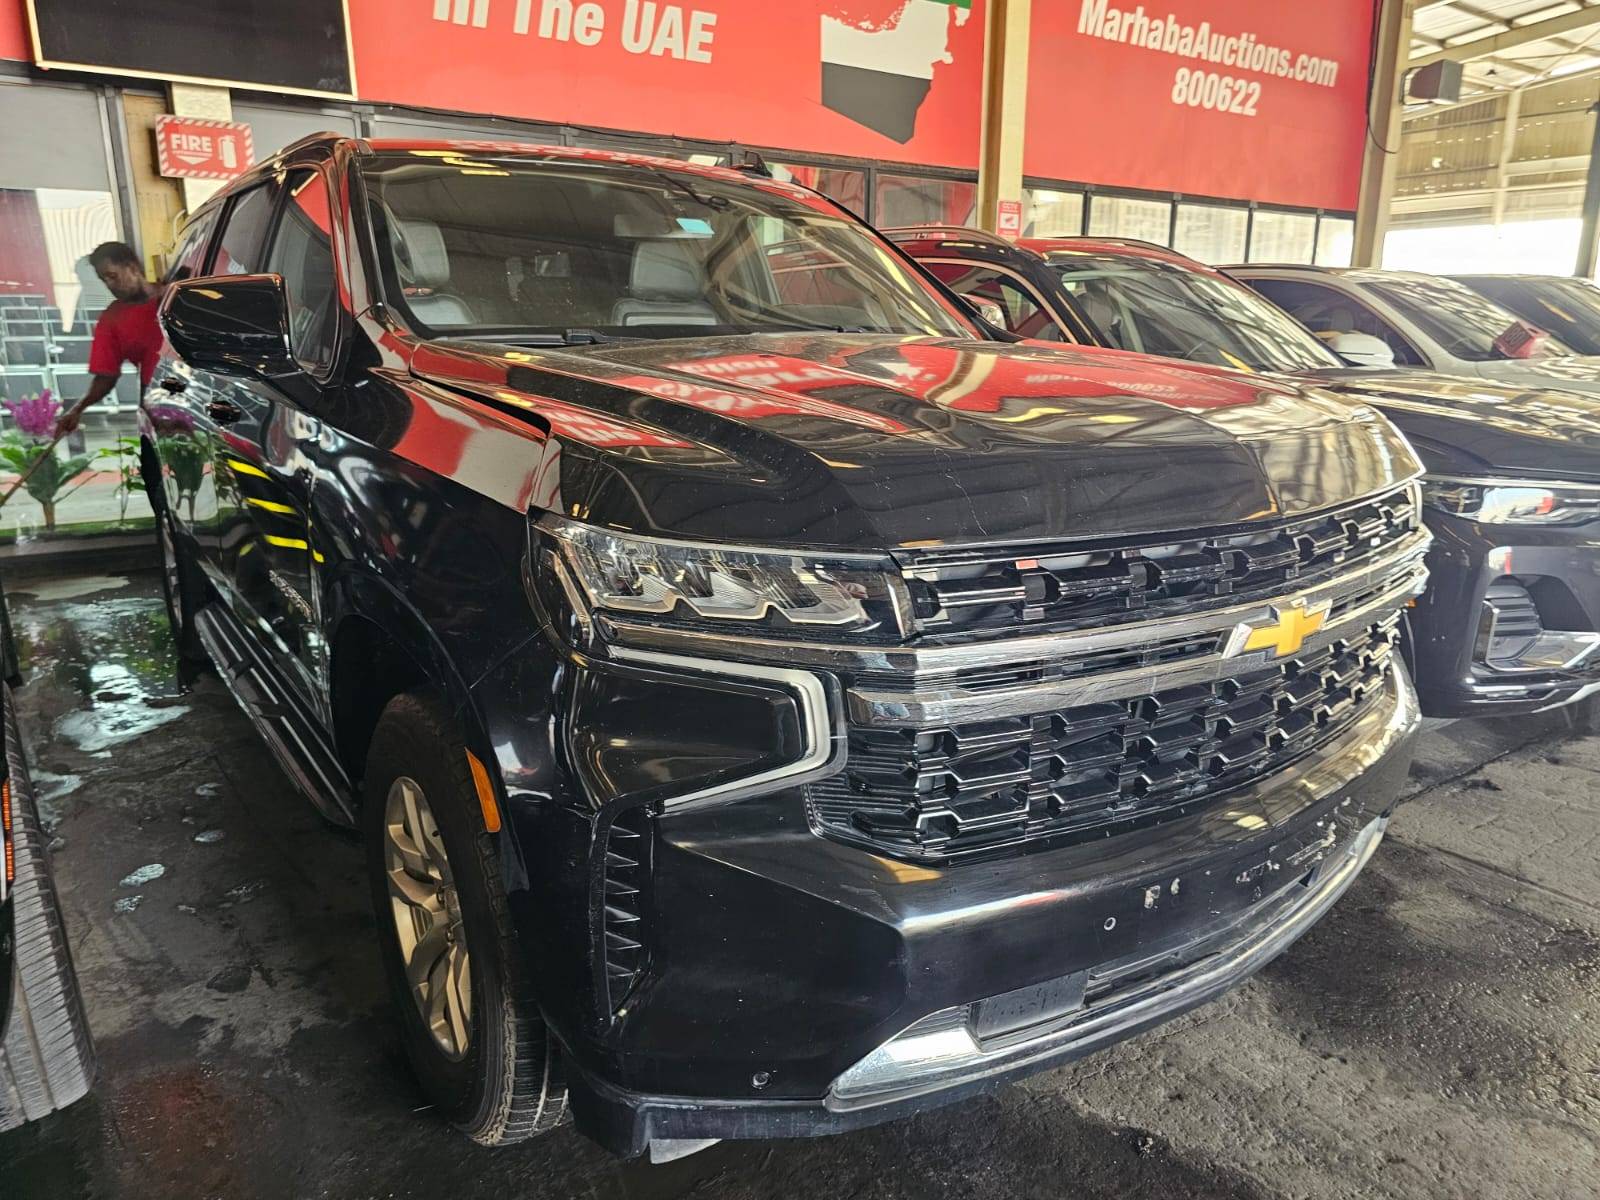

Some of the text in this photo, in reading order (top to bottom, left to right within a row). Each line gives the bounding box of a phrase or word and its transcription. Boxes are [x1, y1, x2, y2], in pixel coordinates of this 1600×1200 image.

[621, 0, 717, 64] UAE
[1077, 0, 1339, 87] MarhabaAuctions.com
[1171, 67, 1261, 116] 800622
[170, 133, 213, 153] FIRE
